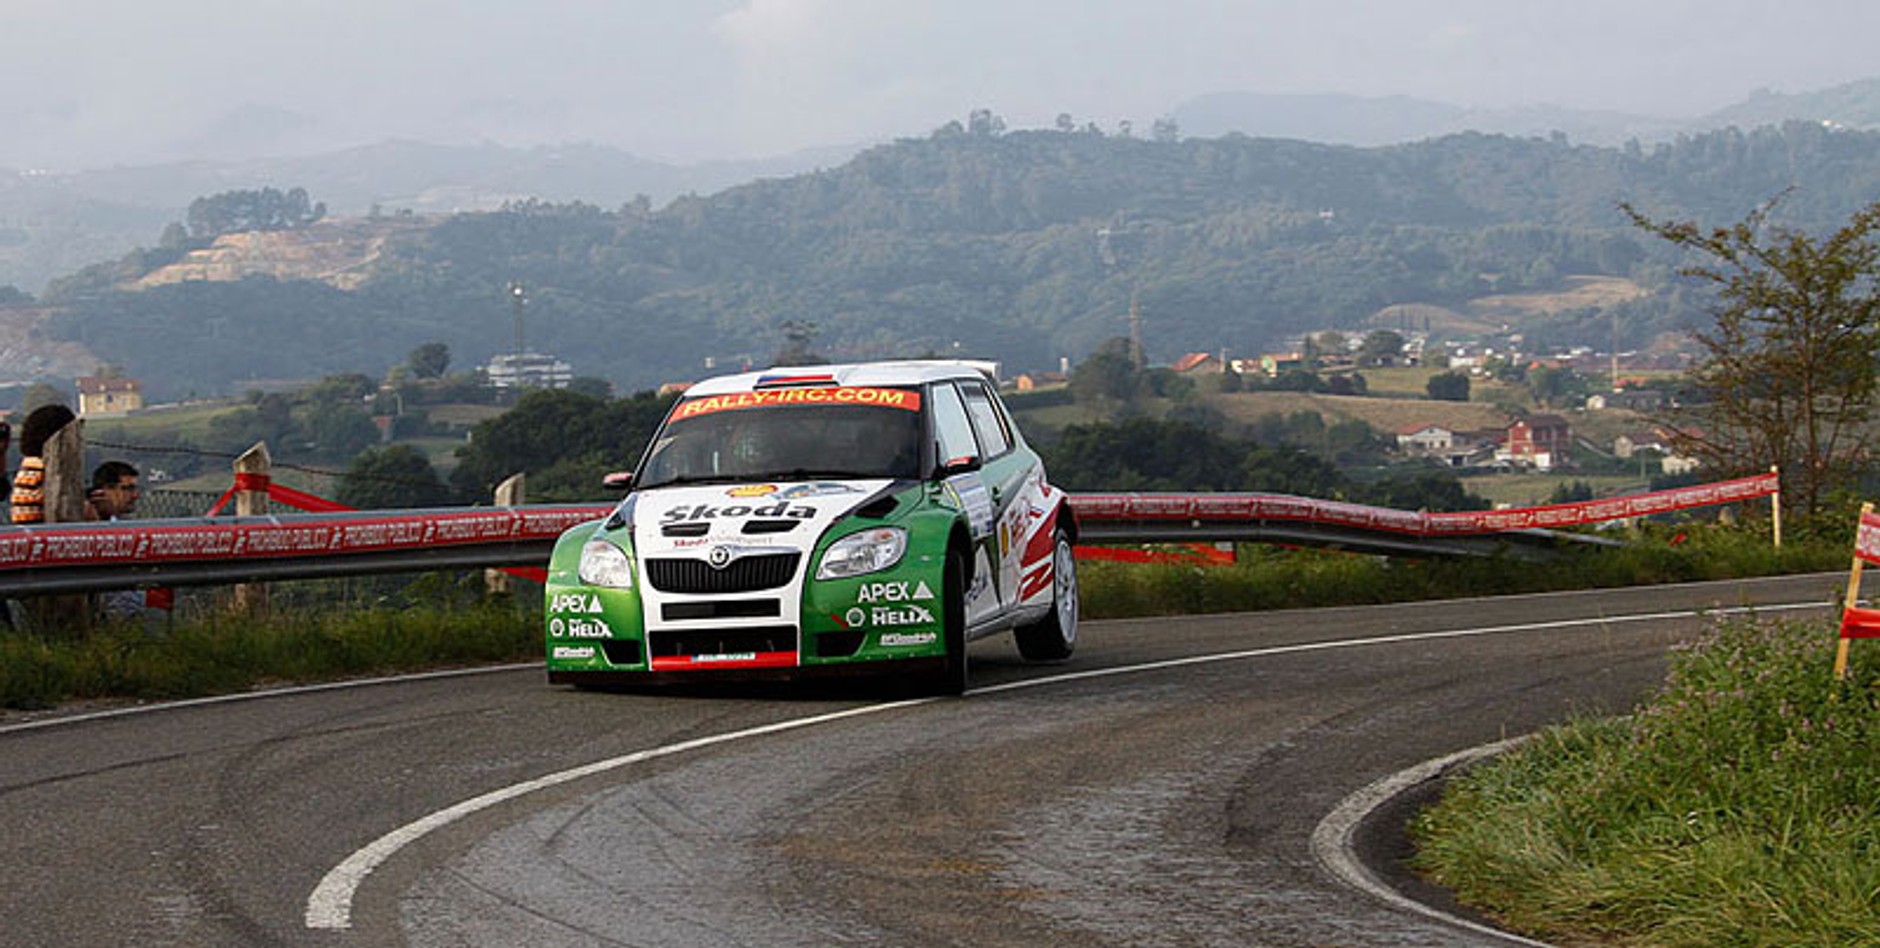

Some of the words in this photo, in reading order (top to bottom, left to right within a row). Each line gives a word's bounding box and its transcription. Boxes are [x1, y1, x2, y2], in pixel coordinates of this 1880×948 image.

[683, 388, 904, 416] RALLY-IRC.COM
[858, 581, 910, 603] APEX
[550, 594, 586, 613] APEX
[872, 604, 935, 626] HELIX
[568, 618, 613, 637] HELIX
